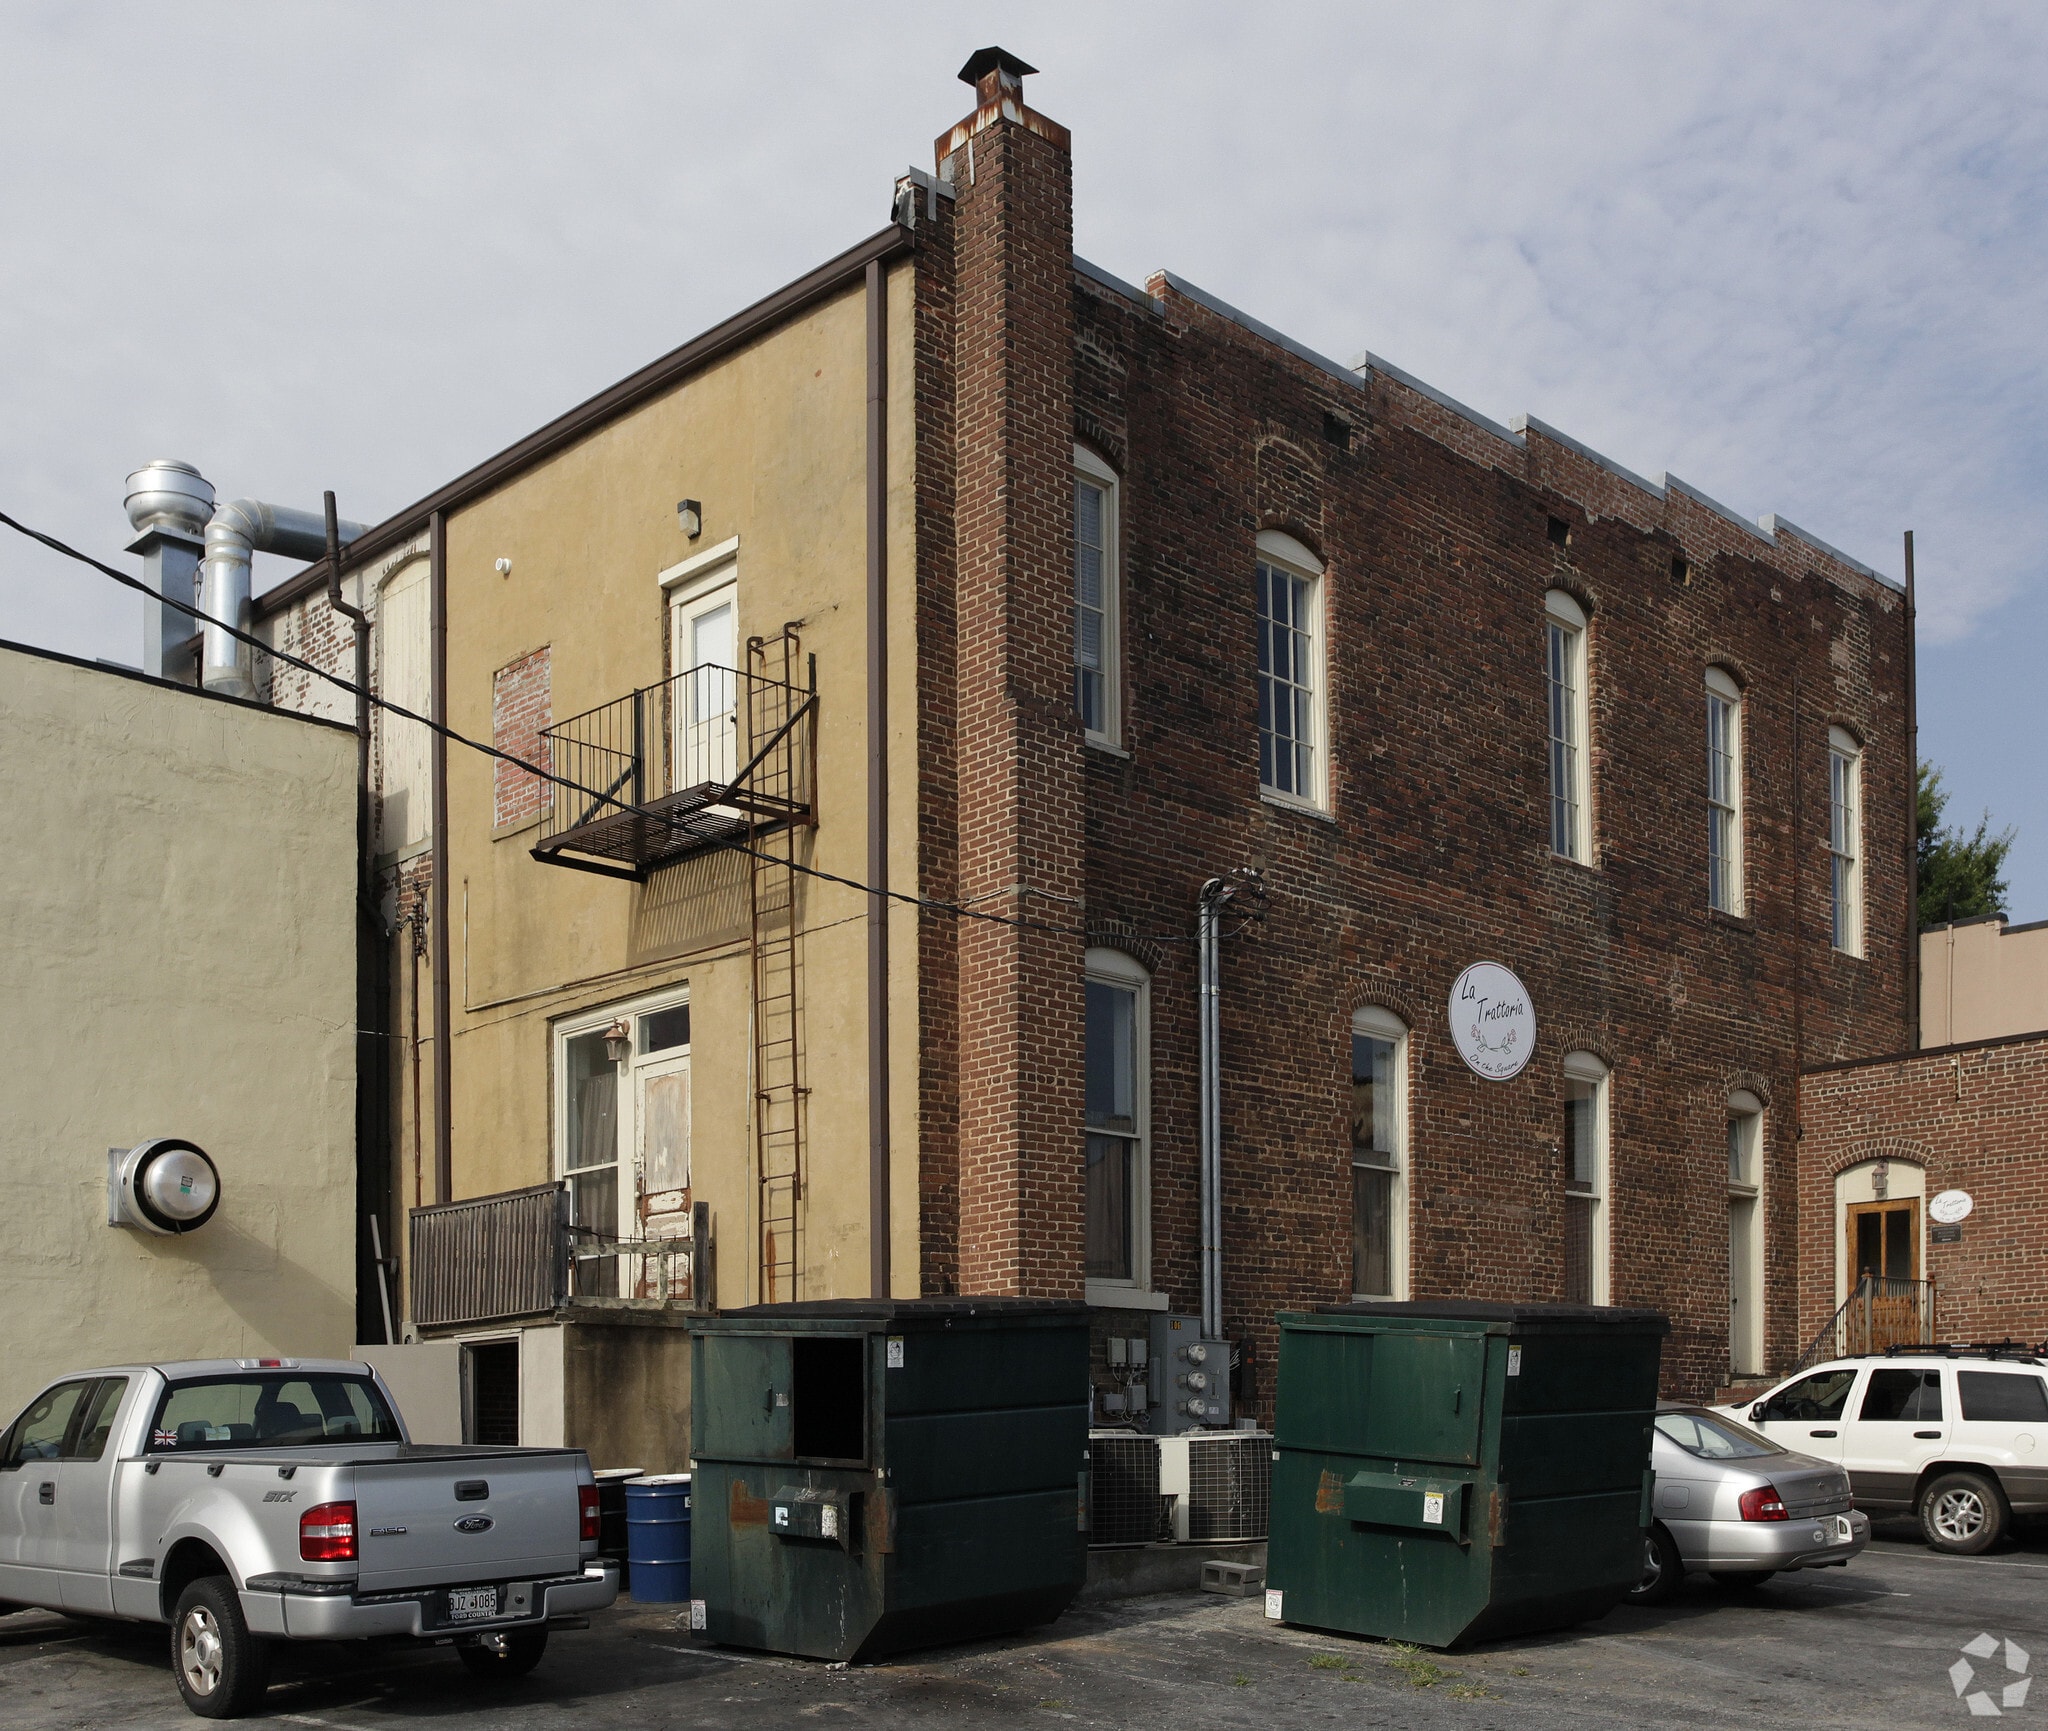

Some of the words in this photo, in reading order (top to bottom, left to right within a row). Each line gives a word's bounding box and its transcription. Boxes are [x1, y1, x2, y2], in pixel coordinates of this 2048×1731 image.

[1461, 973, 1476, 1000] La
[1477, 997, 1524, 1024] Trattoria
[1469, 1053, 1480, 1066] On
[1481, 1062, 1493, 1072] the
[1494, 1060, 1519, 1076] Square
[262, 1490, 298, 1503] STX
